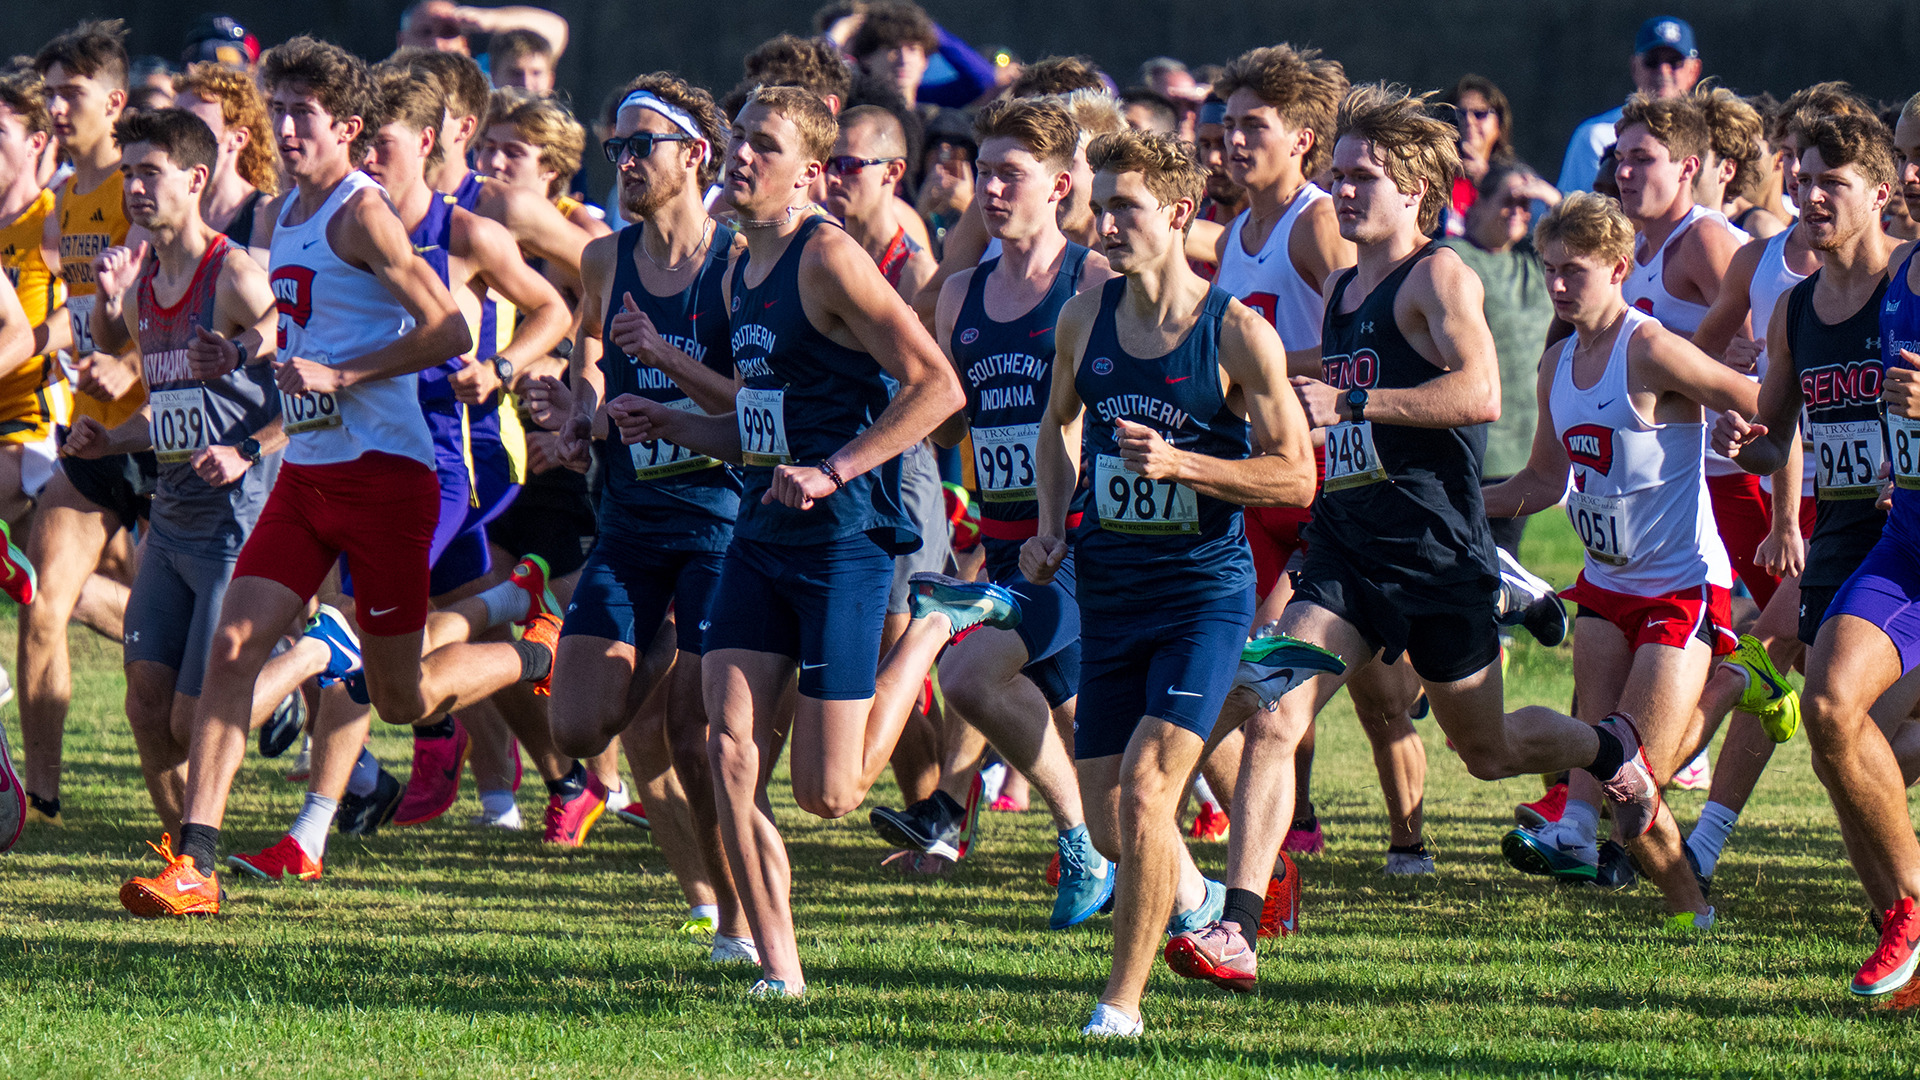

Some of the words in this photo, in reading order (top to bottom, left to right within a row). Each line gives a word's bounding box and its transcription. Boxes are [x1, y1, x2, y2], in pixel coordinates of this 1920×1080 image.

[60, 234, 110, 257] ORTHERN
[73, 311, 97, 350] 94
[732, 323, 776, 357] SOUTHERN
[637, 368, 679, 389] INDIA
[967, 353, 1048, 388] SOUTHERN
[1802, 364, 1883, 407] SEMO
[981, 385, 1035, 411] INDIANA
[1097, 394, 1188, 429] SOUTHERN
[153, 406, 203, 451] 1039
[744, 406, 776, 452] 999
[982, 427, 1015, 438] TRXC
[1568, 435, 1600, 457] WKU
[1823, 423, 1856, 434] TRXC
[980, 443, 1034, 489] 993
[1328, 426, 1367, 477] 948
[1820, 440, 1872, 486] 945
[1109, 475, 1177, 520] 987
[1569, 504, 1618, 554] 1051
